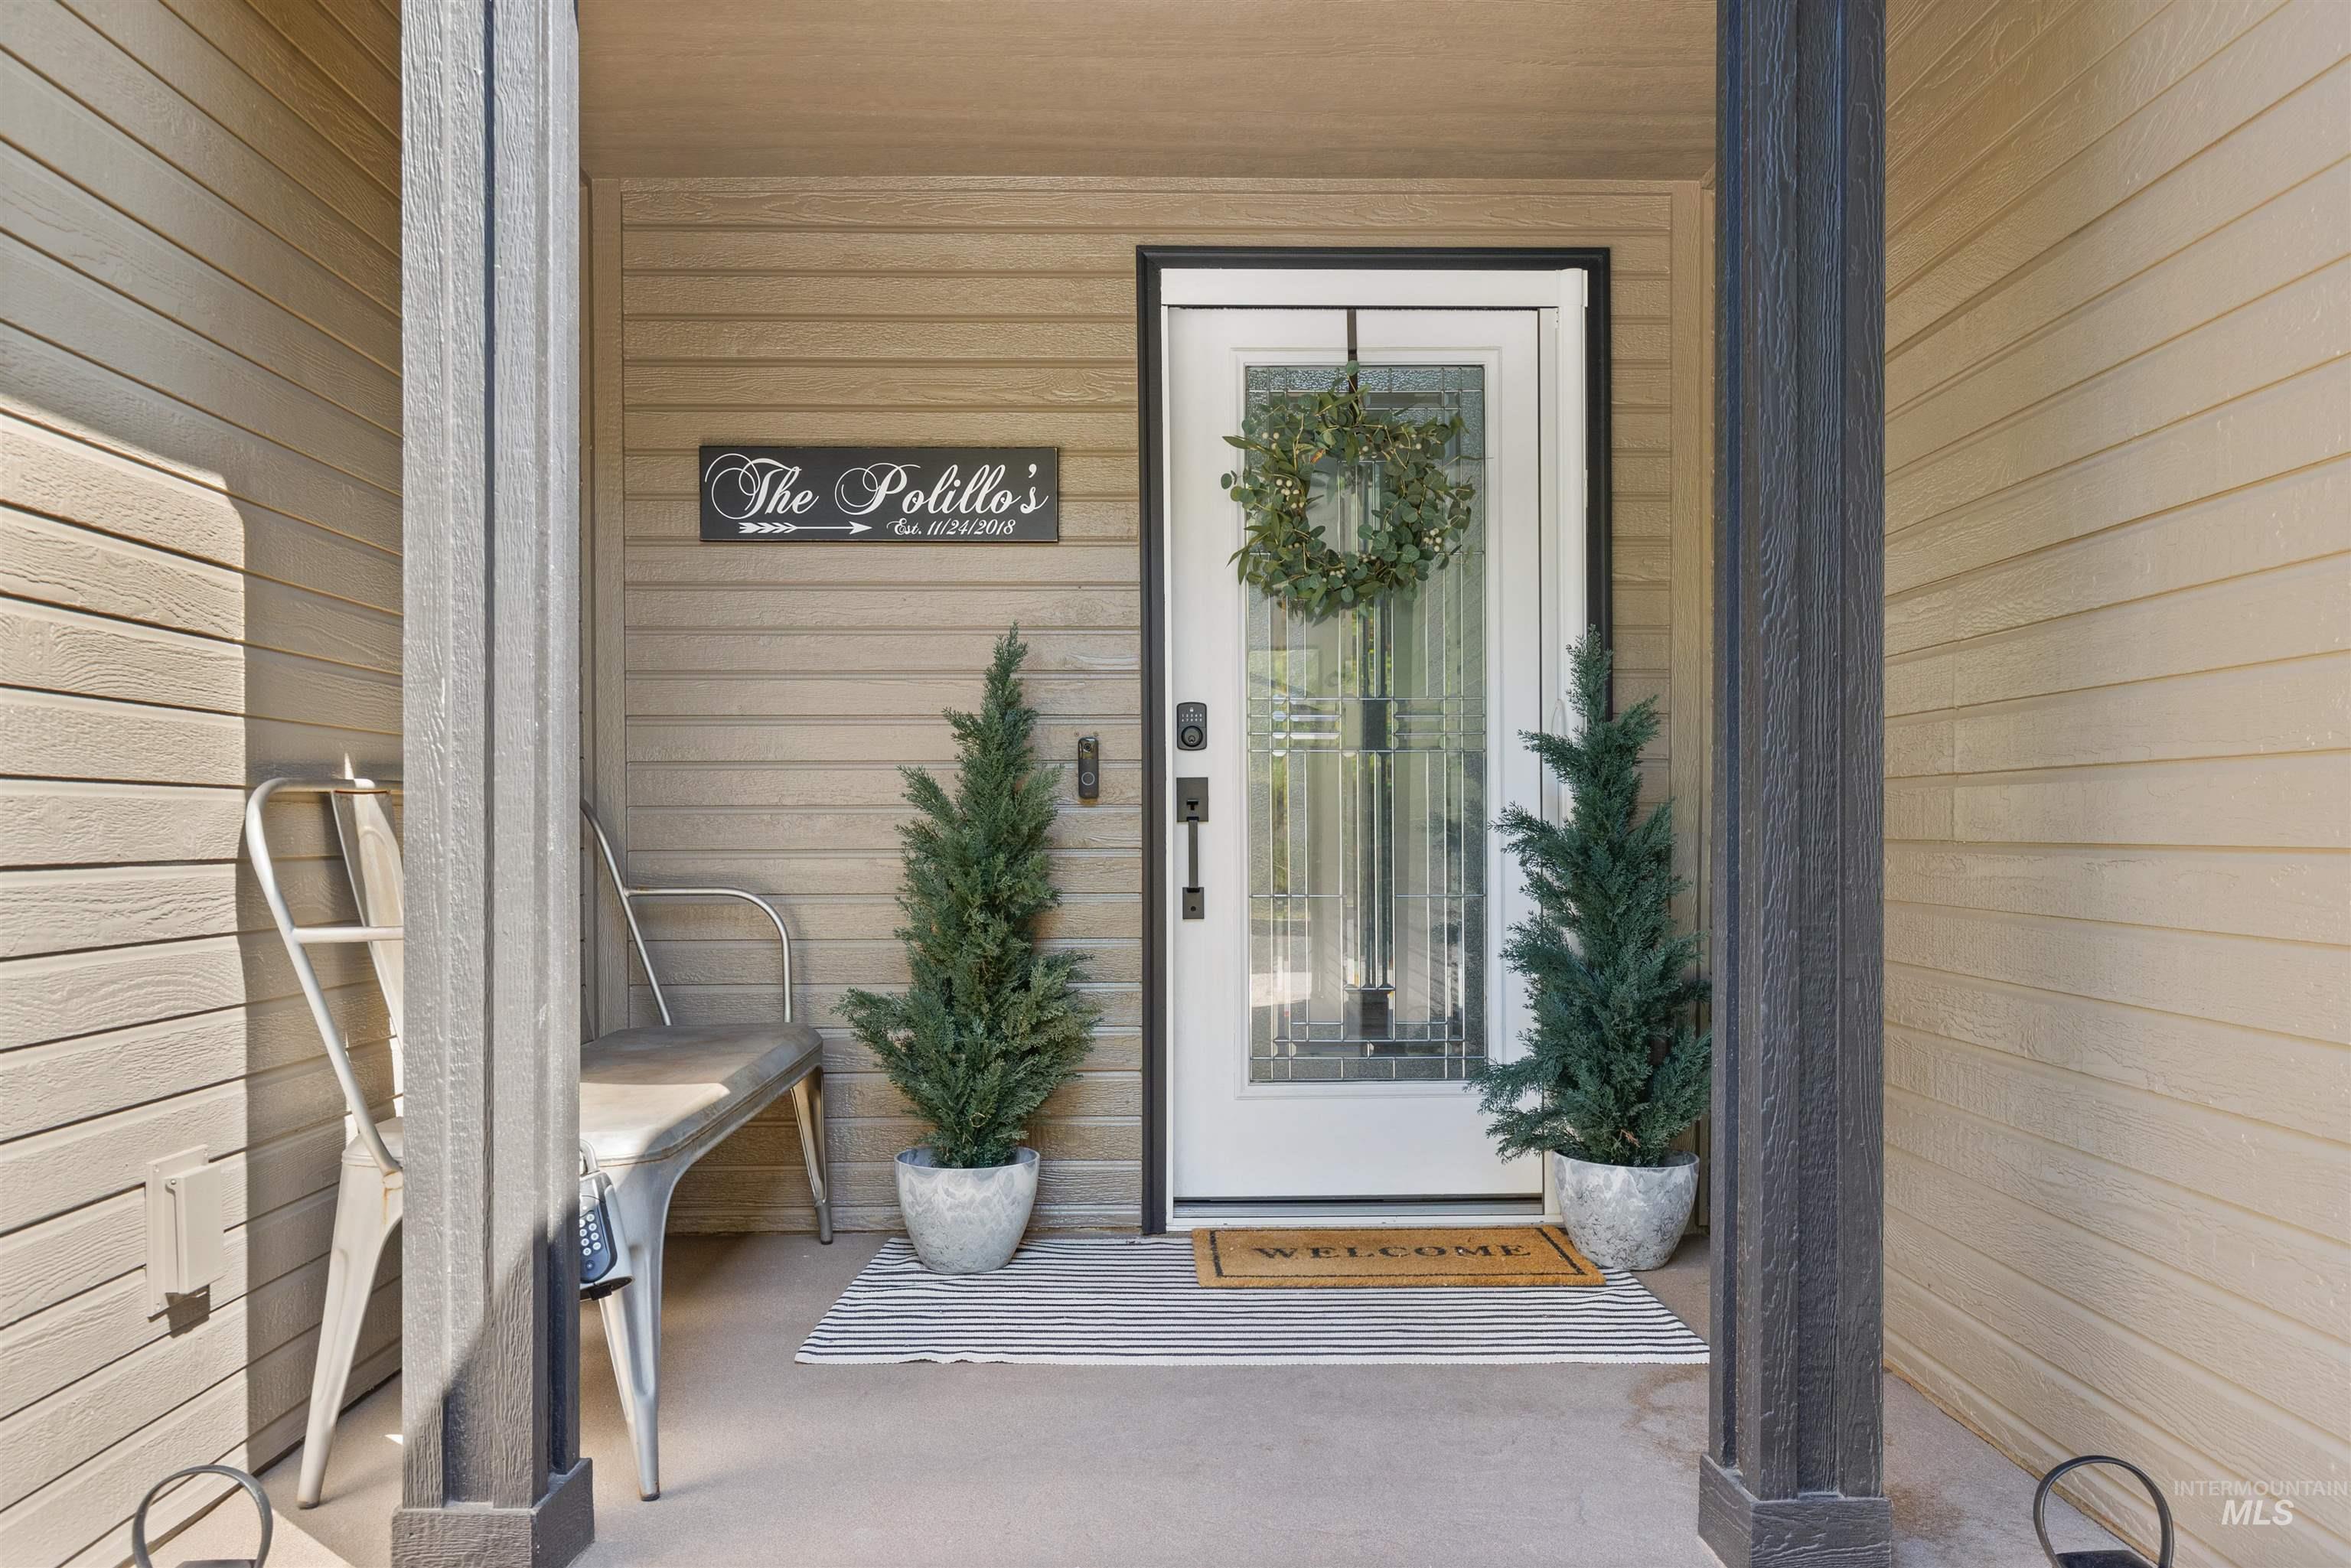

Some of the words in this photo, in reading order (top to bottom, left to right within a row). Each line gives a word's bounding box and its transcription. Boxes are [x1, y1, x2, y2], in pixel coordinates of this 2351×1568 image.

[704, 453, 819, 520] The
[835, 462, 1048, 516] Polillo's
[887, 518, 921, 536] Est.
[927, 518, 1016, 536] 11/24/2018
[1253, 1244, 1532, 1260] WELCOME
